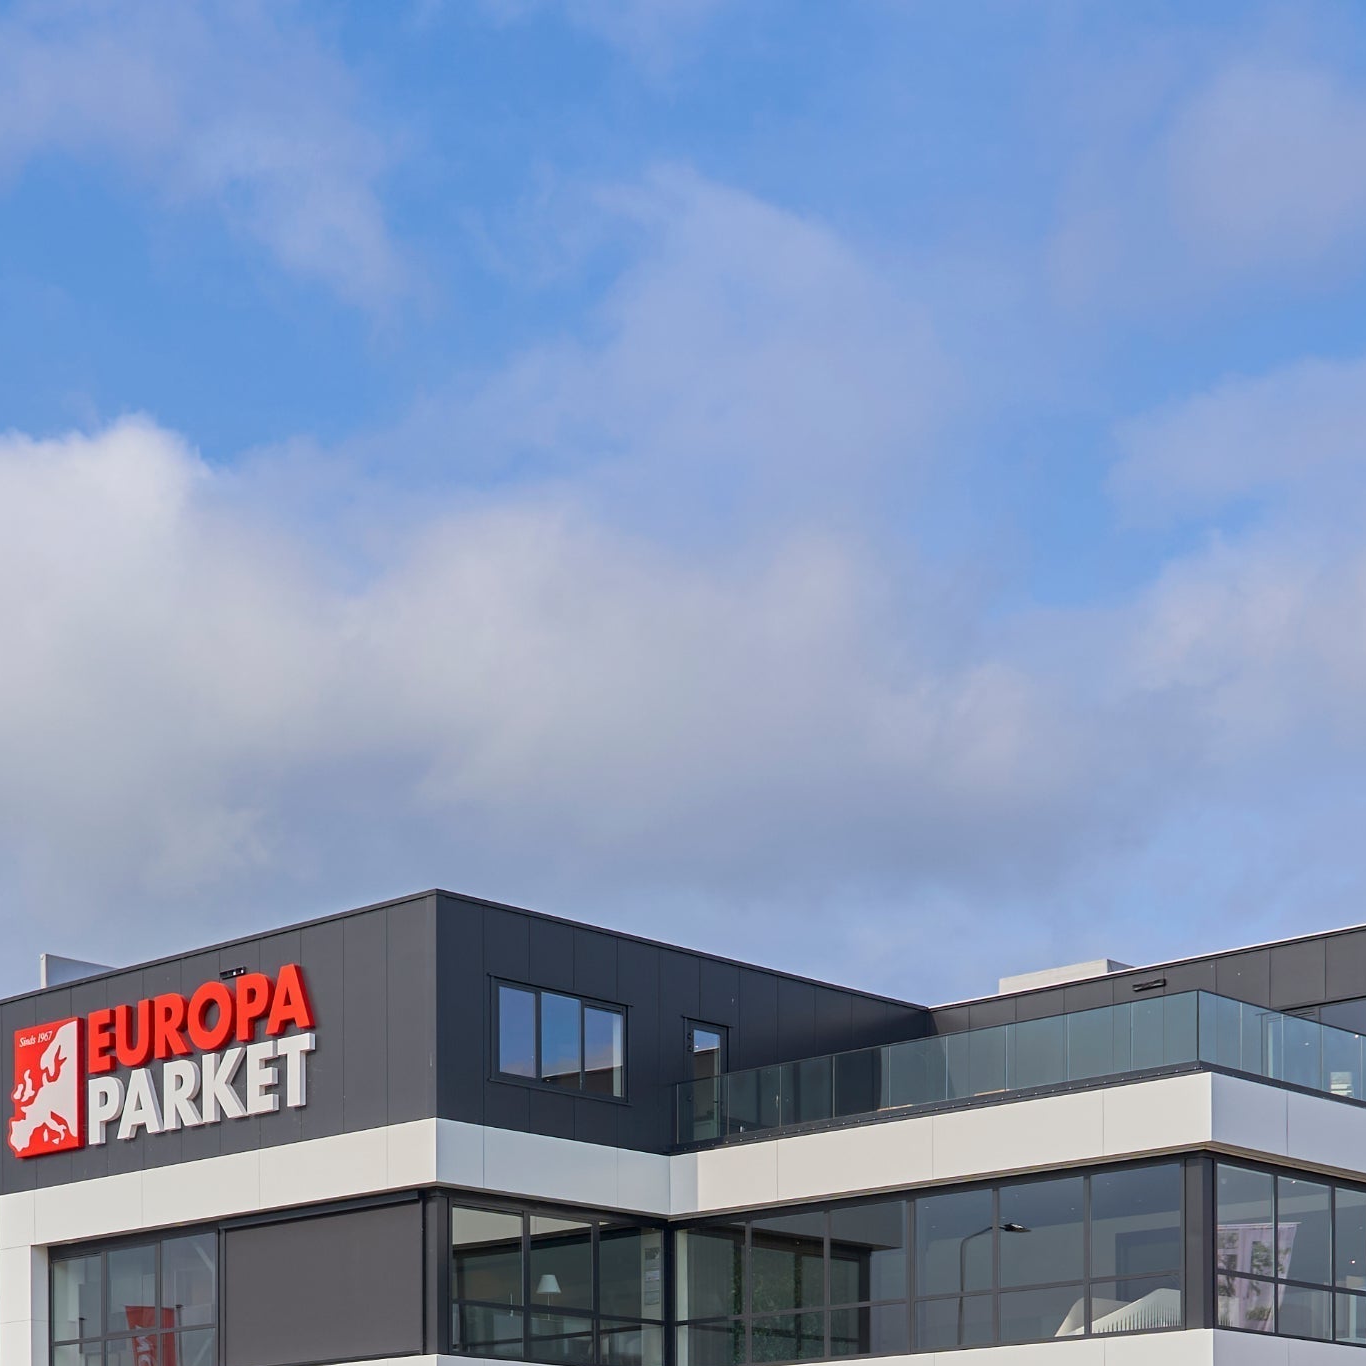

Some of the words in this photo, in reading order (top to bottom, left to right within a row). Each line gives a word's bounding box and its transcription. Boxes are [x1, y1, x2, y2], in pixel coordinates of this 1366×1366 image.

[19, 1035, 36, 1047] Sinds
[37, 1030, 52, 1043] 1967
[88, 963, 315, 1073] EUROPA
[88, 1032, 316, 1146] PARKET
